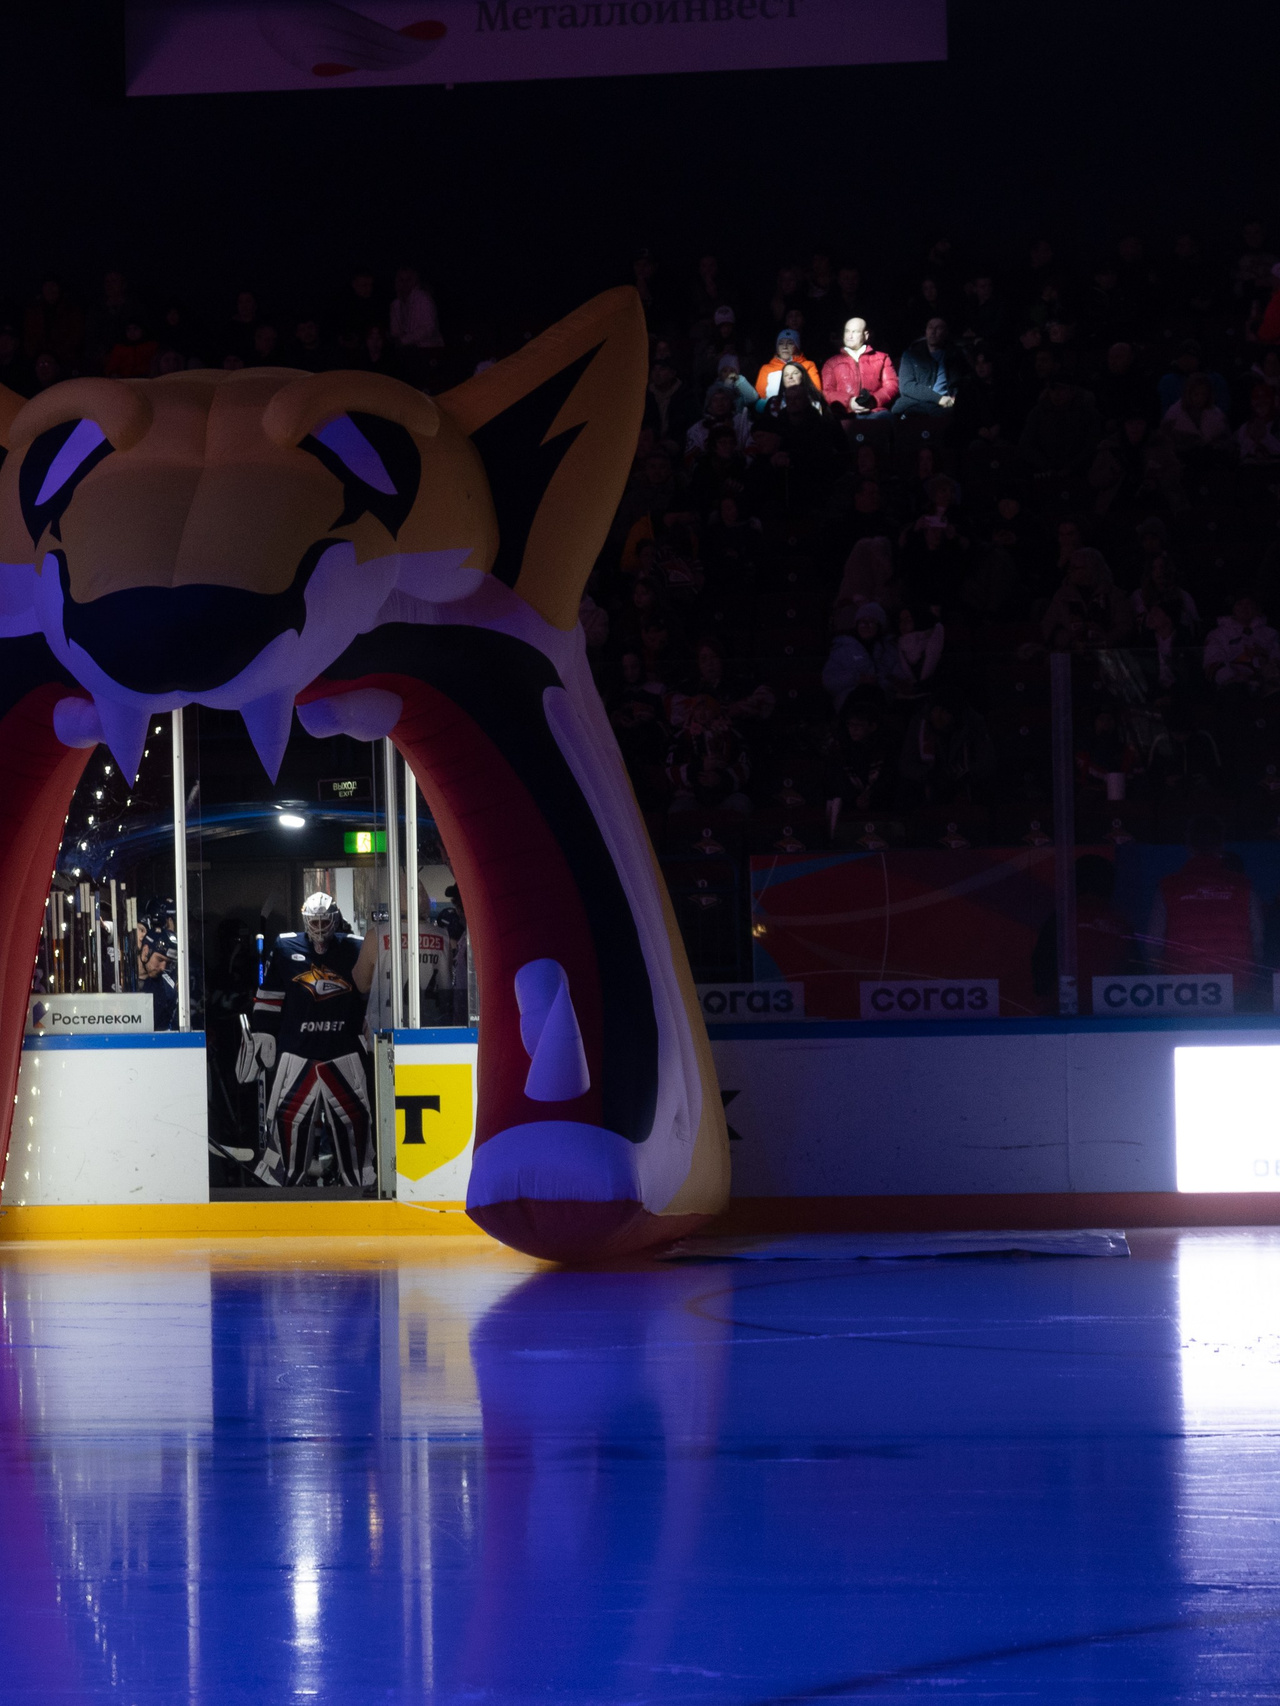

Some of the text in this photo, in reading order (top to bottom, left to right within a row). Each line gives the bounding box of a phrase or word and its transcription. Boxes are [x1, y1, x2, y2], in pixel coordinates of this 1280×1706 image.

[476, 0, 799, 31] Металлоинвест
[698, 989, 795, 1014] огаз
[52, 1012, 142, 1026] Ростелеком
[300, 1020, 346, 1033] FONBET
